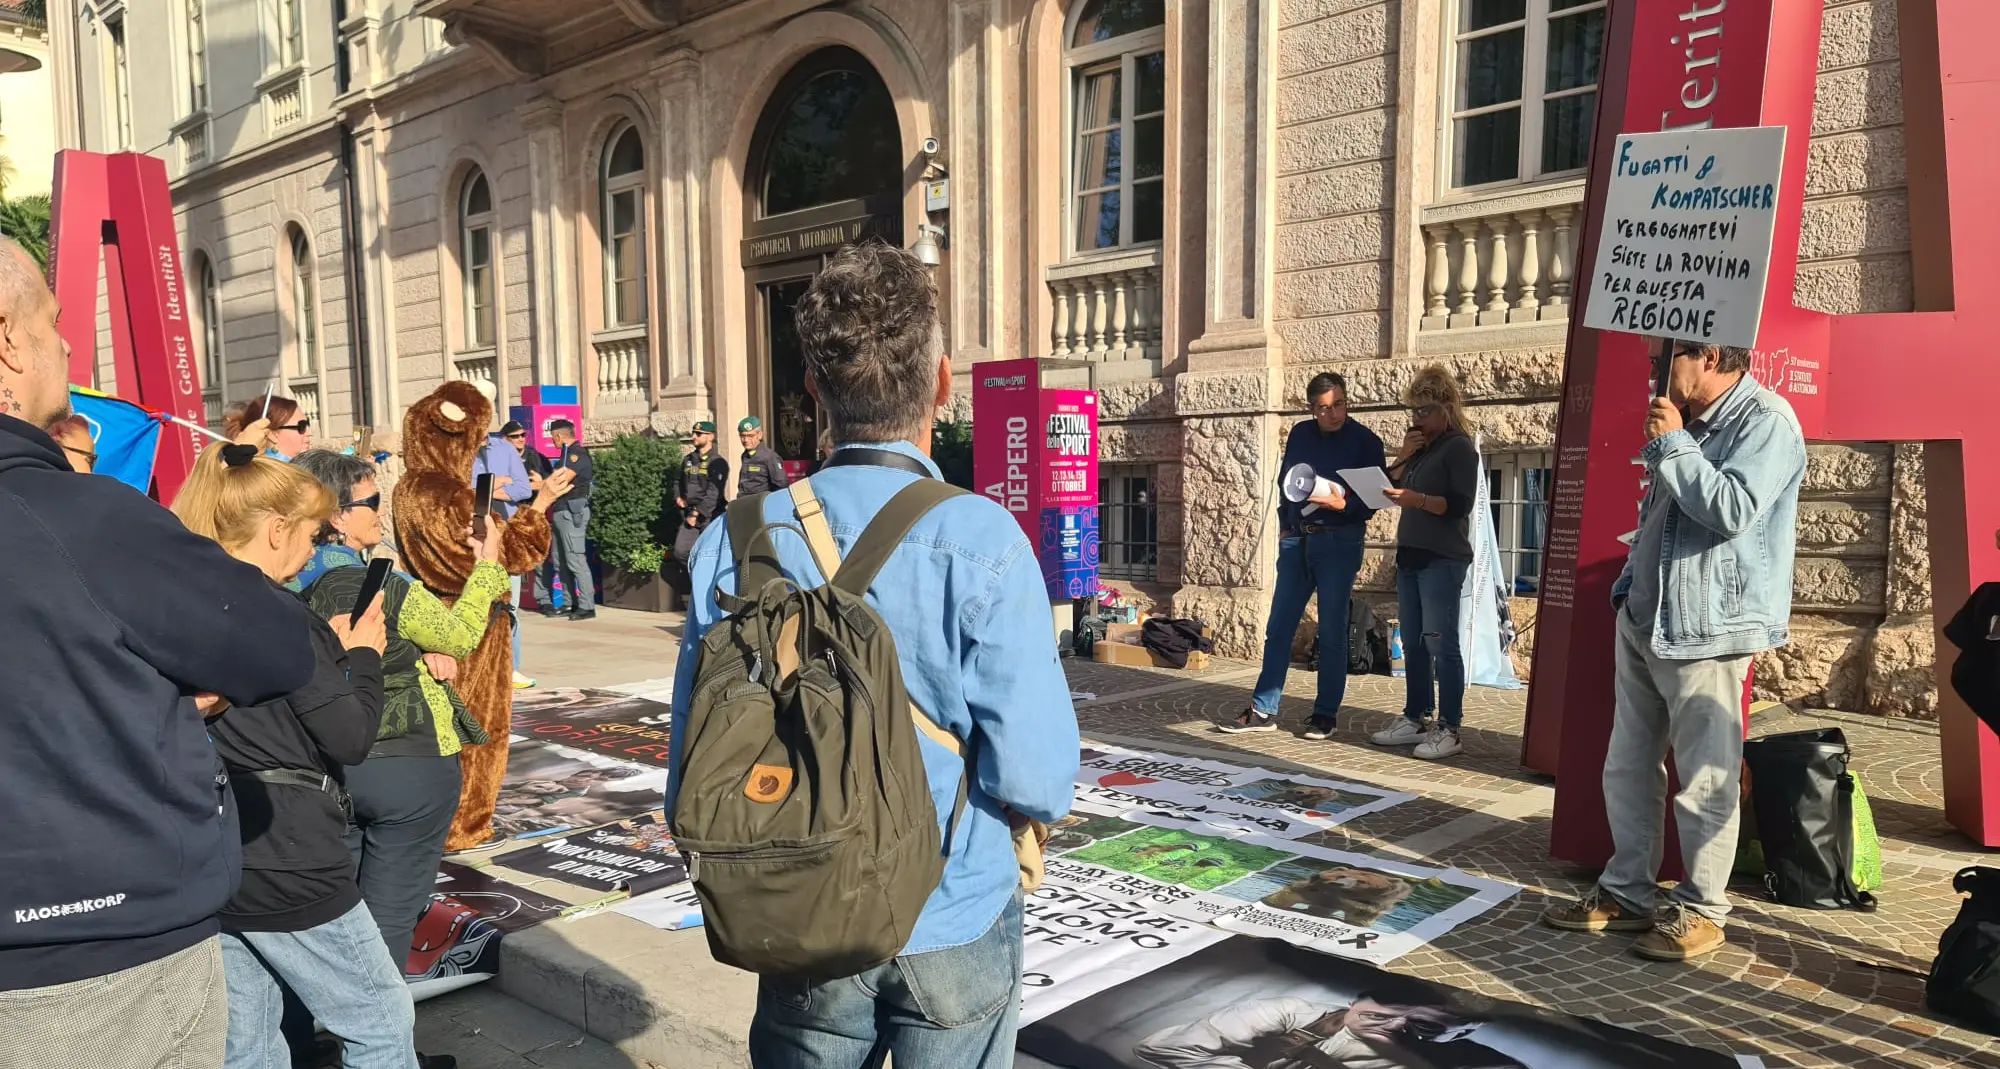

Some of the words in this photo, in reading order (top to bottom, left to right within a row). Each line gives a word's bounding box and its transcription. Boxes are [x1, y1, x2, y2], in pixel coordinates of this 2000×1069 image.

[750, 236, 791, 258] PROVINCIA
[799, 226, 844, 251] AUTONOMA
[1616, 215, 1738, 242] VERGOGNATEVI
[1655, 252, 1673, 272] LA
[1681, 250, 1750, 280] ROVINA
[159, 245, 183, 321] Identität
[1603, 272, 1631, 293] PER
[1636, 279, 1705, 301] QUESTA
[1611, 296, 1716, 337] REGIONE
[175, 336, 194, 395] Gebiet
[1050, 413, 1091, 434] FESTIVAL
[1060, 434, 1091, 456] SPORT
[1006, 416, 1028, 511] DEPERO
[1052, 481, 1082, 493] OTTOBRE
[548, 860, 580, 872] DI
[1115, 875, 1196, 900] BEARS
[14, 905, 60, 923] KAOS
[82, 893, 126, 913] KORP
[1031, 886, 1190, 933] OTIZIA:
